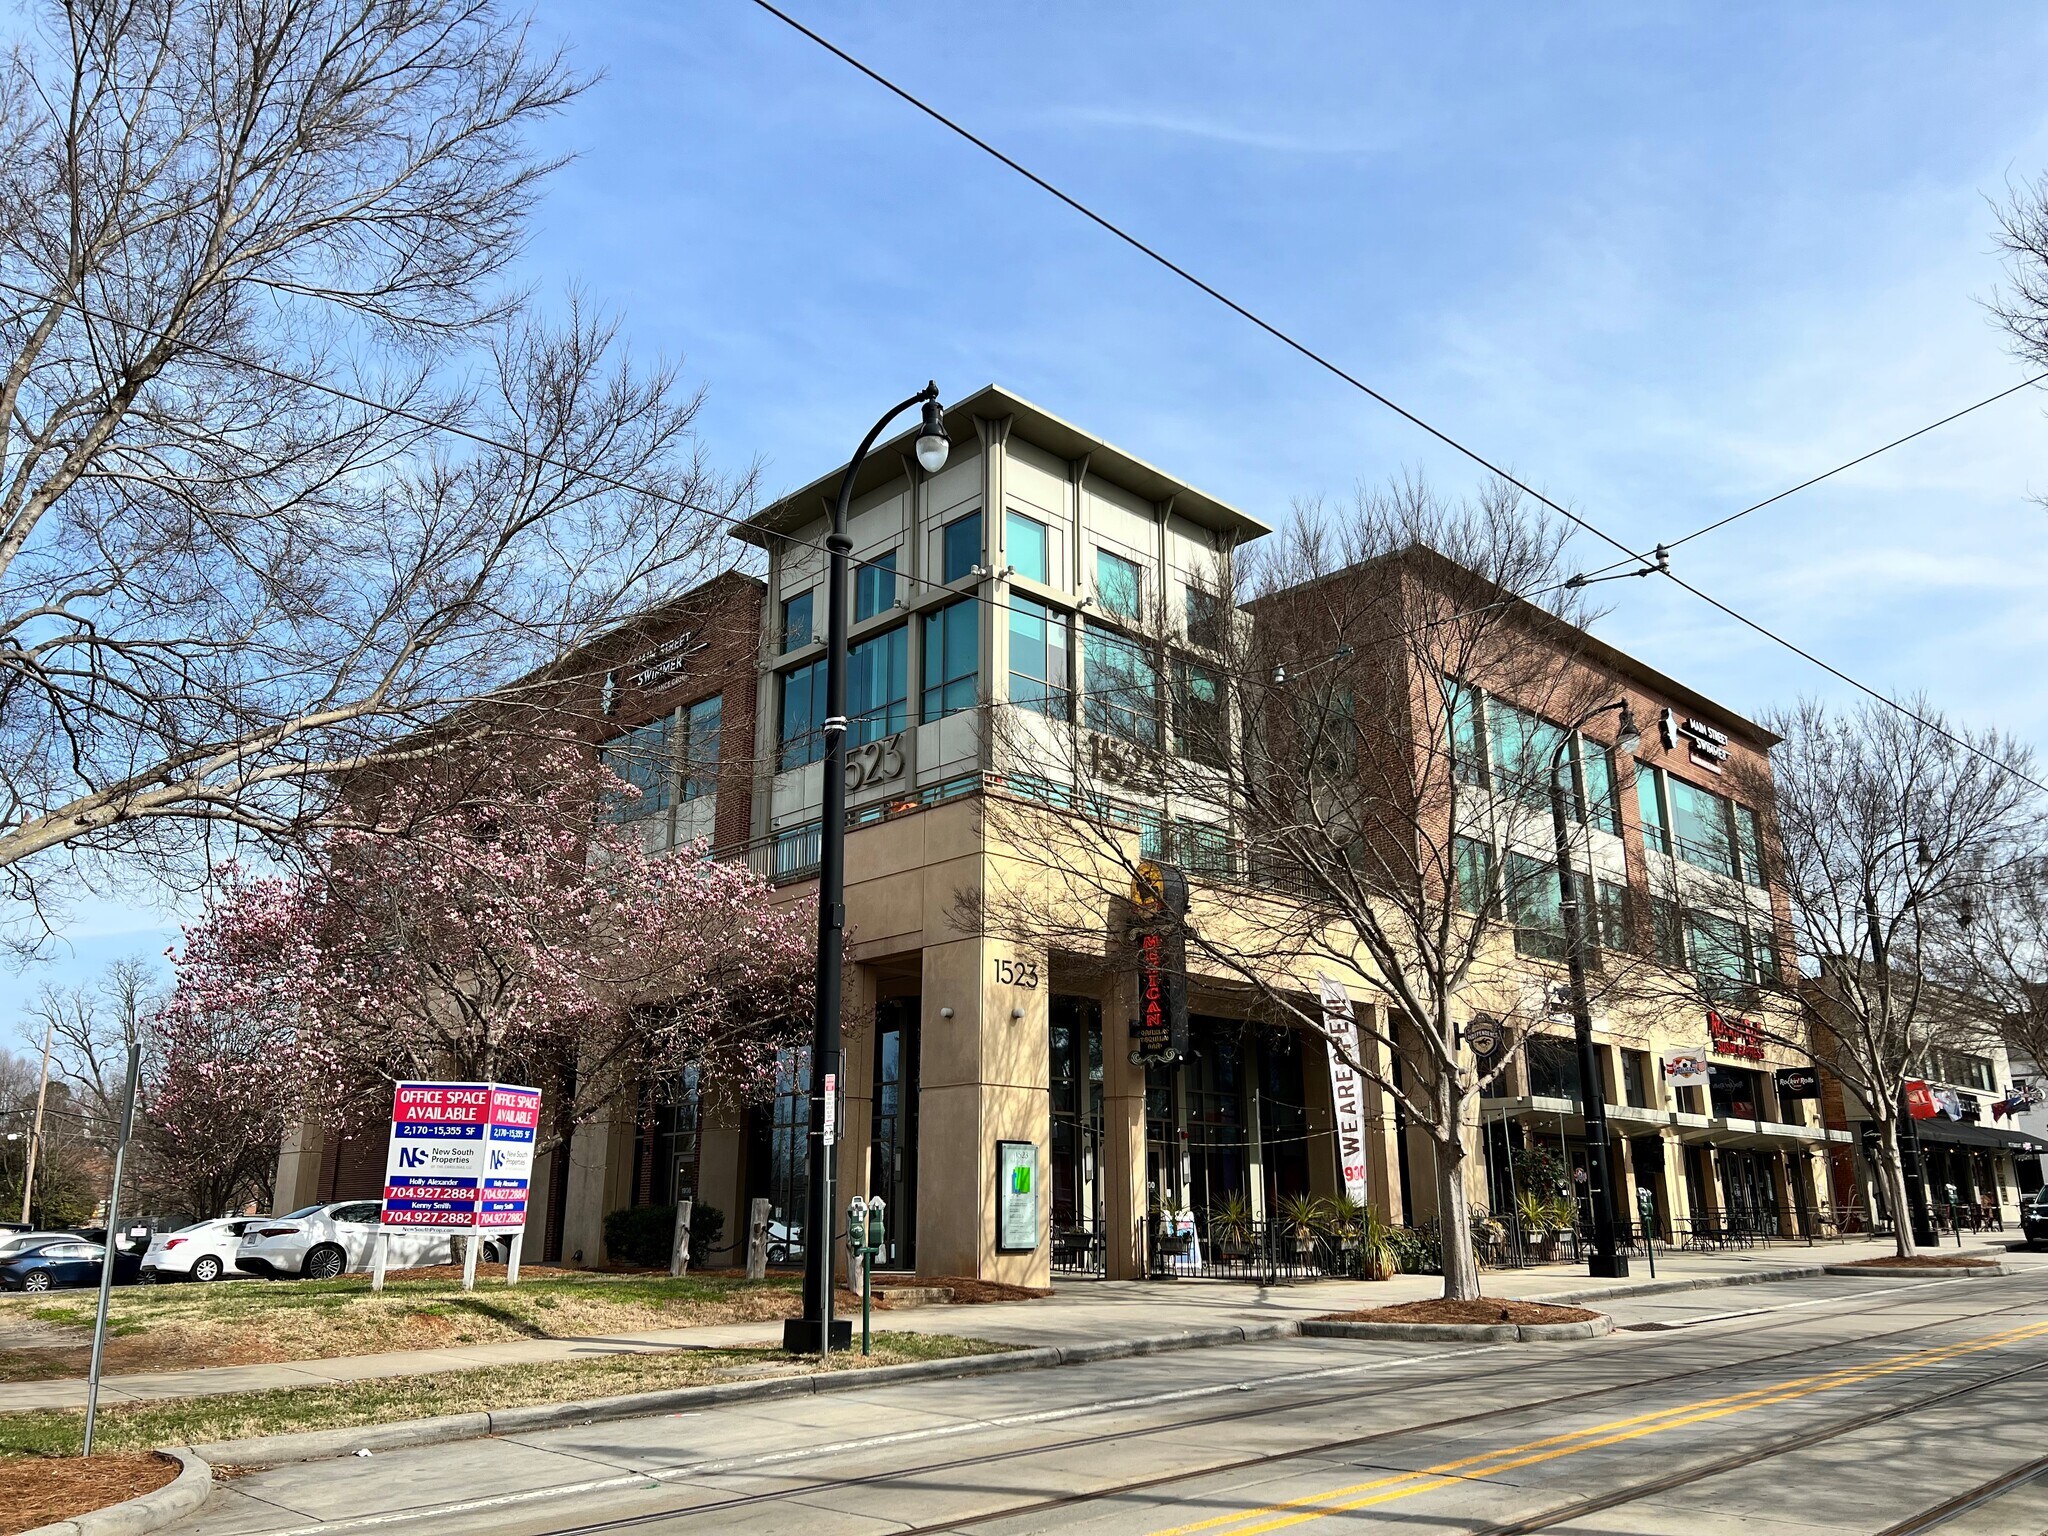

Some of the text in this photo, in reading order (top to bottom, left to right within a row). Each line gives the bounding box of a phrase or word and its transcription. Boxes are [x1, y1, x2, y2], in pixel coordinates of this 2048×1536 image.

[637, 656, 683, 686] SWIMMER
[1707, 726, 1729, 747] STREET
[844, 733, 906, 791] 523
[993, 958, 1039, 988] 1523
[1717, 1040, 1765, 1060] SUSHI EXPRESS
[400, 1090, 487, 1105] OFFICE SPACE
[1335, 1068, 1356, 1115] ARE
[493, 1092, 538, 1110] OFFICE SPACE
[406, 1106, 477, 1121] AVAILABLE
[496, 1108, 532, 1125] AVAILABLE
[403, 1125, 476, 1136] 2,170-15,355 SF
[1342, 1119, 1360, 1158] WE
[398, 1147, 429, 1168] NS
[432, 1147, 475, 1156] New South
[489, 1149, 506, 1170] NS
[431, 1155, 470, 1165] Properties
[409, 1178, 426, 1186] Holly
[389, 1187, 475, 1199] 704.927.2884
[483, 1188, 526, 1200] 704.927.2884
[411, 1202, 452, 1210] Kenny Smith
[387, 1211, 472, 1224] 704.927.2882
[480, 1213, 524, 1224] 704.927.2882
